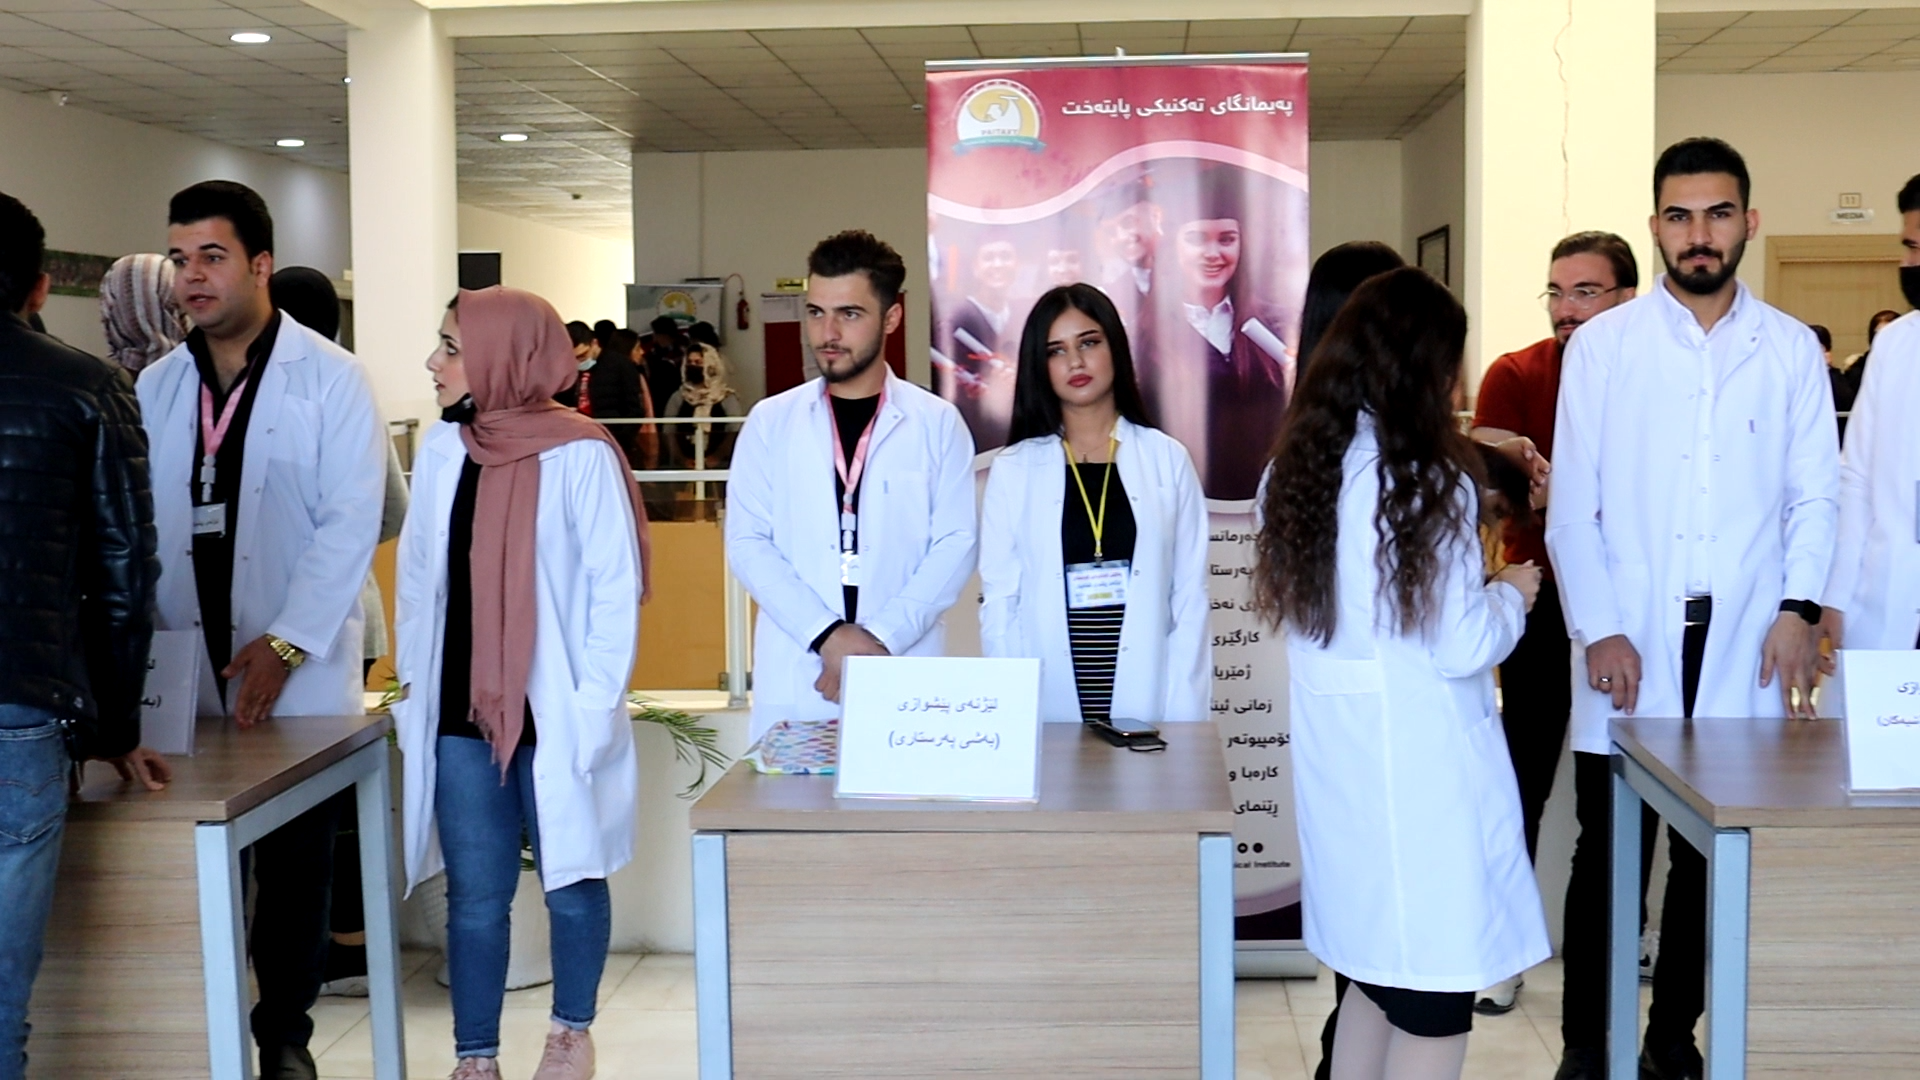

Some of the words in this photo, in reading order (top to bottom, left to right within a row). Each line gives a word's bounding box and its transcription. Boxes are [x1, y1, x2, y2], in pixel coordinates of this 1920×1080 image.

[1061, 97, 1132, 120] پایتەخت
[1135, 98, 1206, 117] تەکنیکی
[1209, 93, 1294, 117] پەیمانگای
[1836, 212, 1865, 220] MEDIA
[1233, 698, 1272, 714] زمانی
